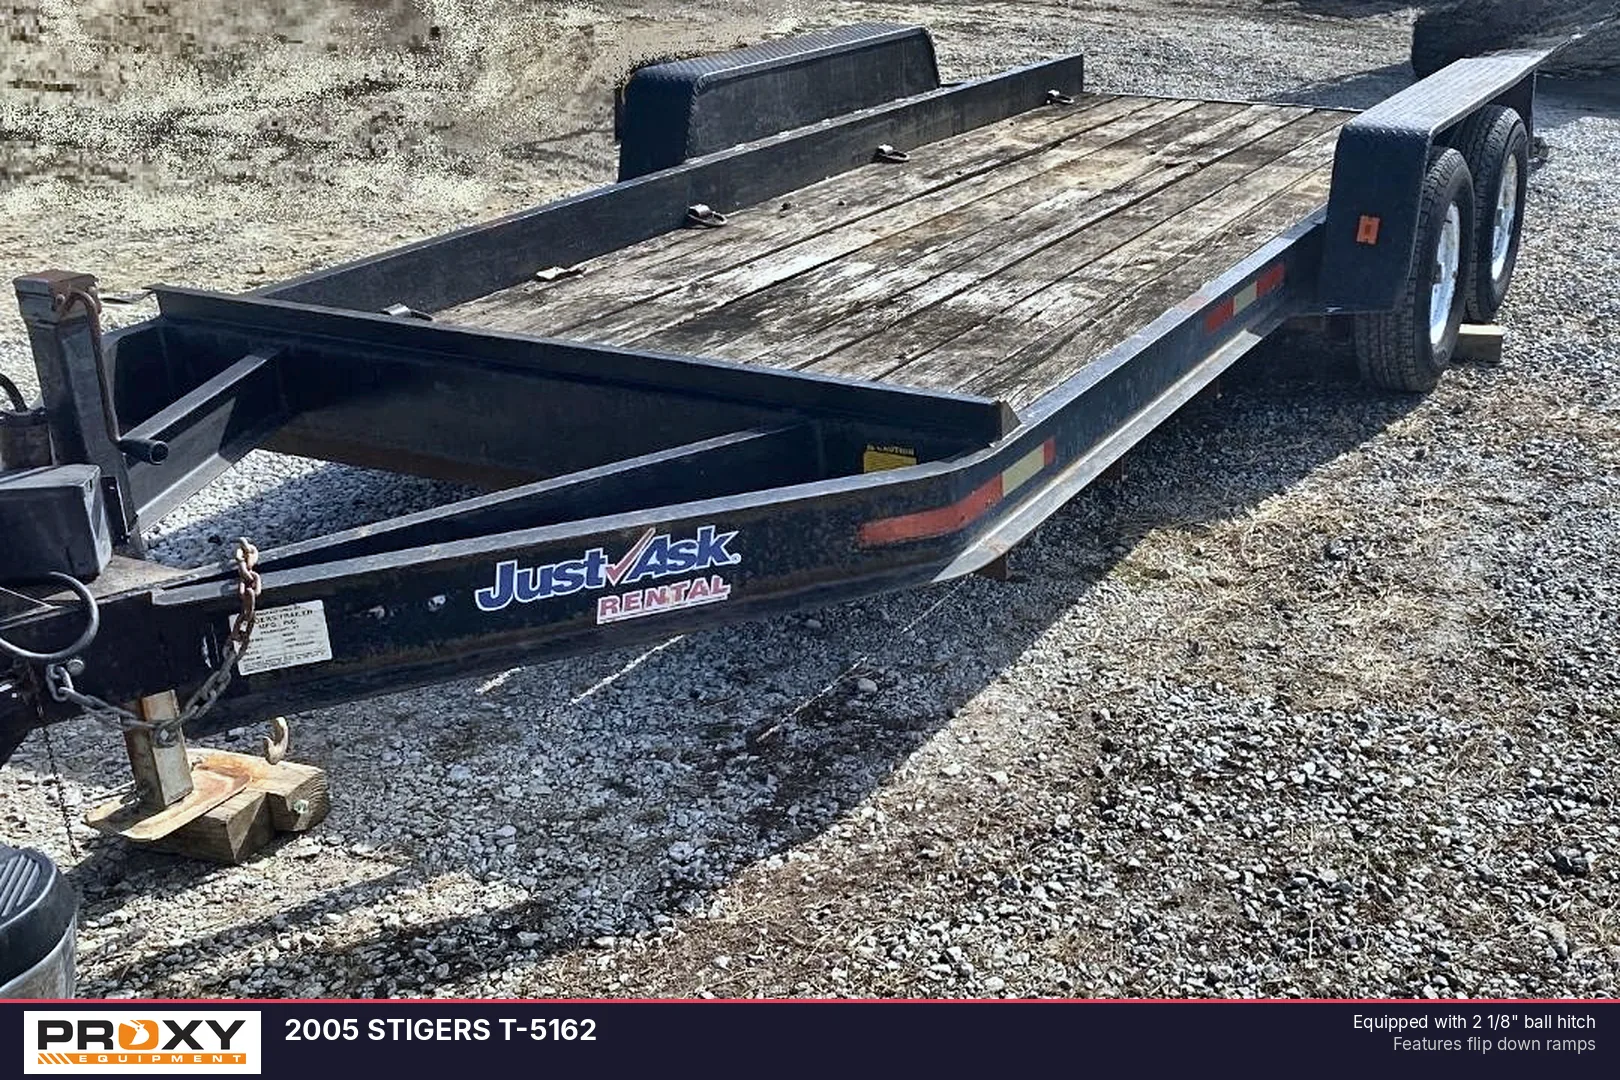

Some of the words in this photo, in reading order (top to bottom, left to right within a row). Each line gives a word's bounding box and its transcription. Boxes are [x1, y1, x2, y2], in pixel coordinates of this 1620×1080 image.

[475, 548, 608, 612] Just
[620, 525, 739, 585] Ask
[598, 575, 731, 620] RENTAL
